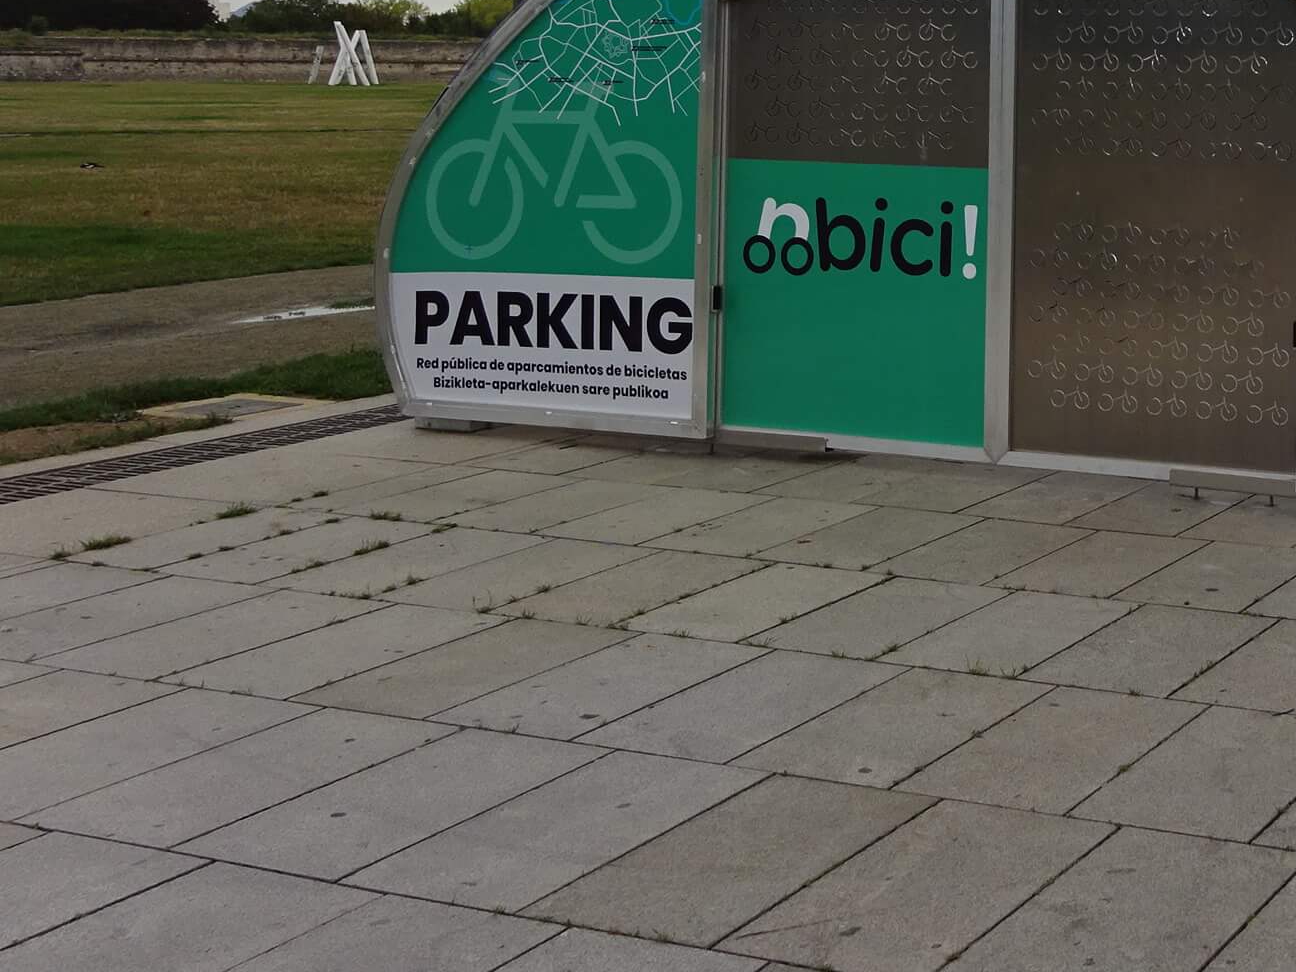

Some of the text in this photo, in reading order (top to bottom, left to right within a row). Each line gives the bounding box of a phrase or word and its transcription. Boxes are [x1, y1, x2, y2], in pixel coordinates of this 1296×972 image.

[414, 290, 693, 355] PARKING
[416, 357, 688, 380] Red pública de aparcamientos de bicicletas
[433, 376, 669, 400] Bizikleta-aparkalekuen sare publikoa
